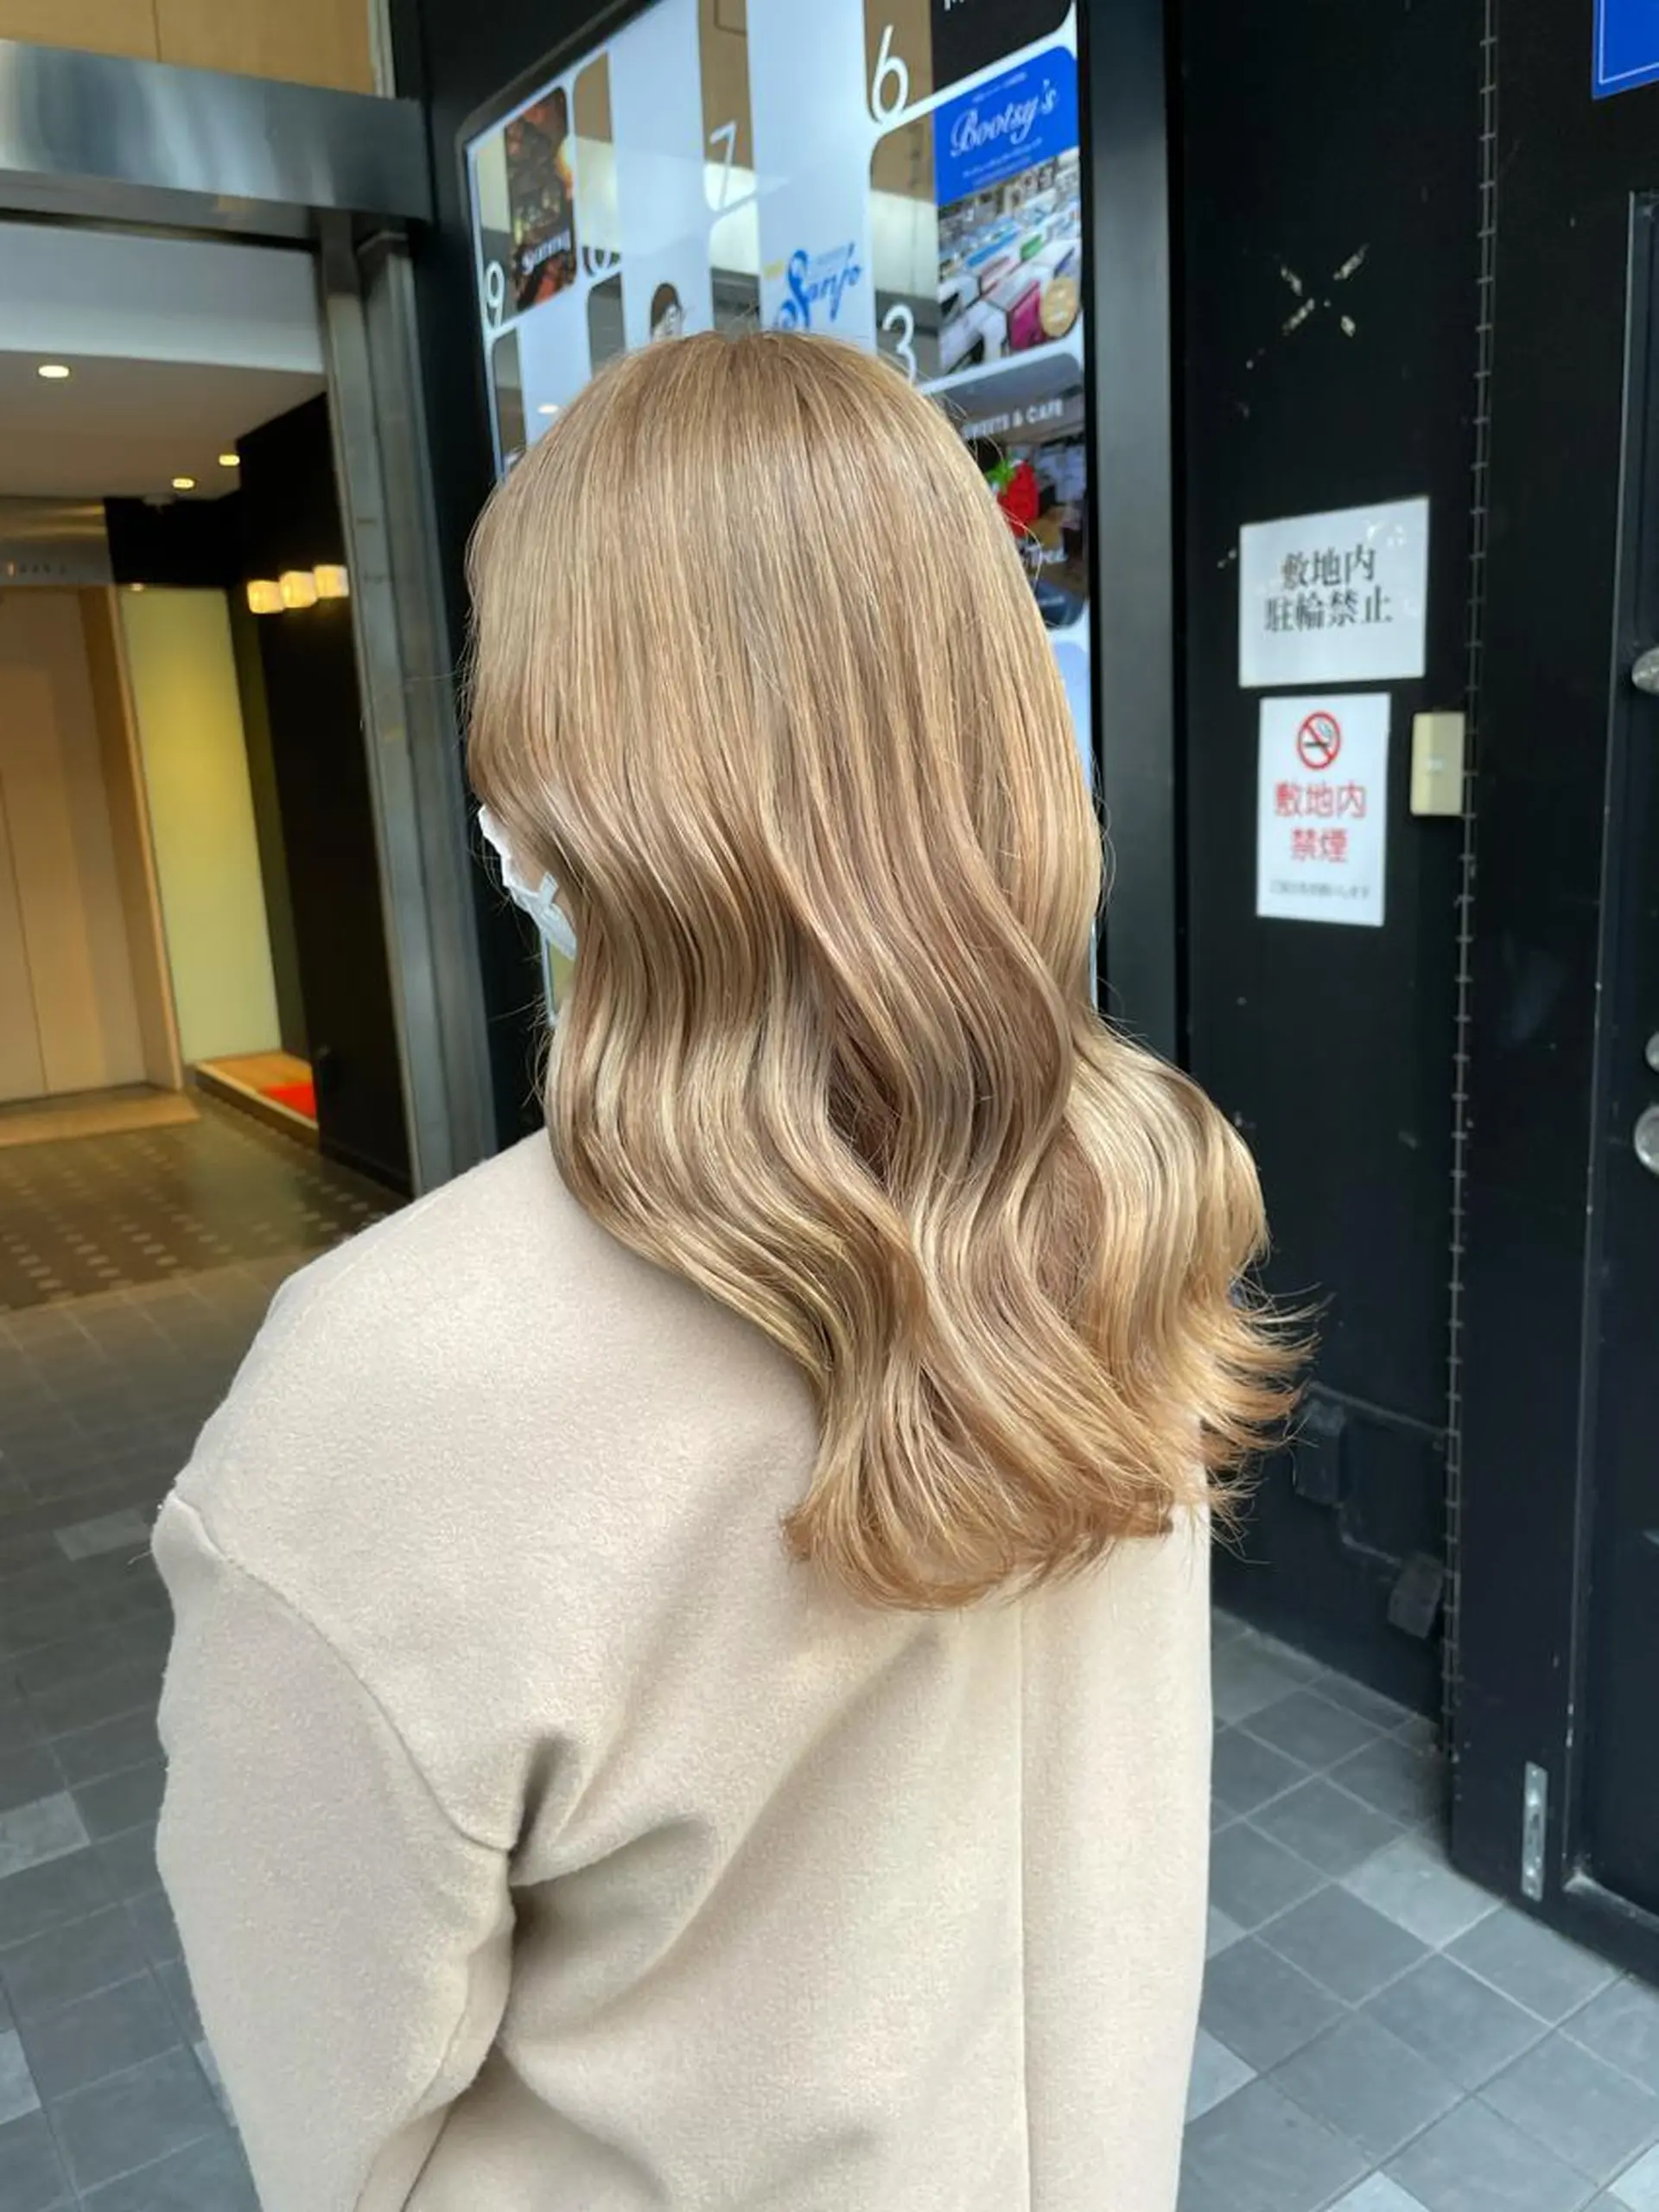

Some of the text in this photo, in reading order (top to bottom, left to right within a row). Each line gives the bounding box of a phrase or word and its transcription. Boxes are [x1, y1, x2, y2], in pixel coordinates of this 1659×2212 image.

[872, 24, 909, 123] 6
[950, 79, 1058, 157] Bootsy's
[710, 120, 736, 210] 7
[486, 261, 505, 329] 9
[1281, 543, 1376, 589] 敷地内
[1263, 585, 1394, 634] 駐輪禁止
[1274, 779, 1368, 818] 敷地内
[1292, 827, 1348, 863] 禁煙
